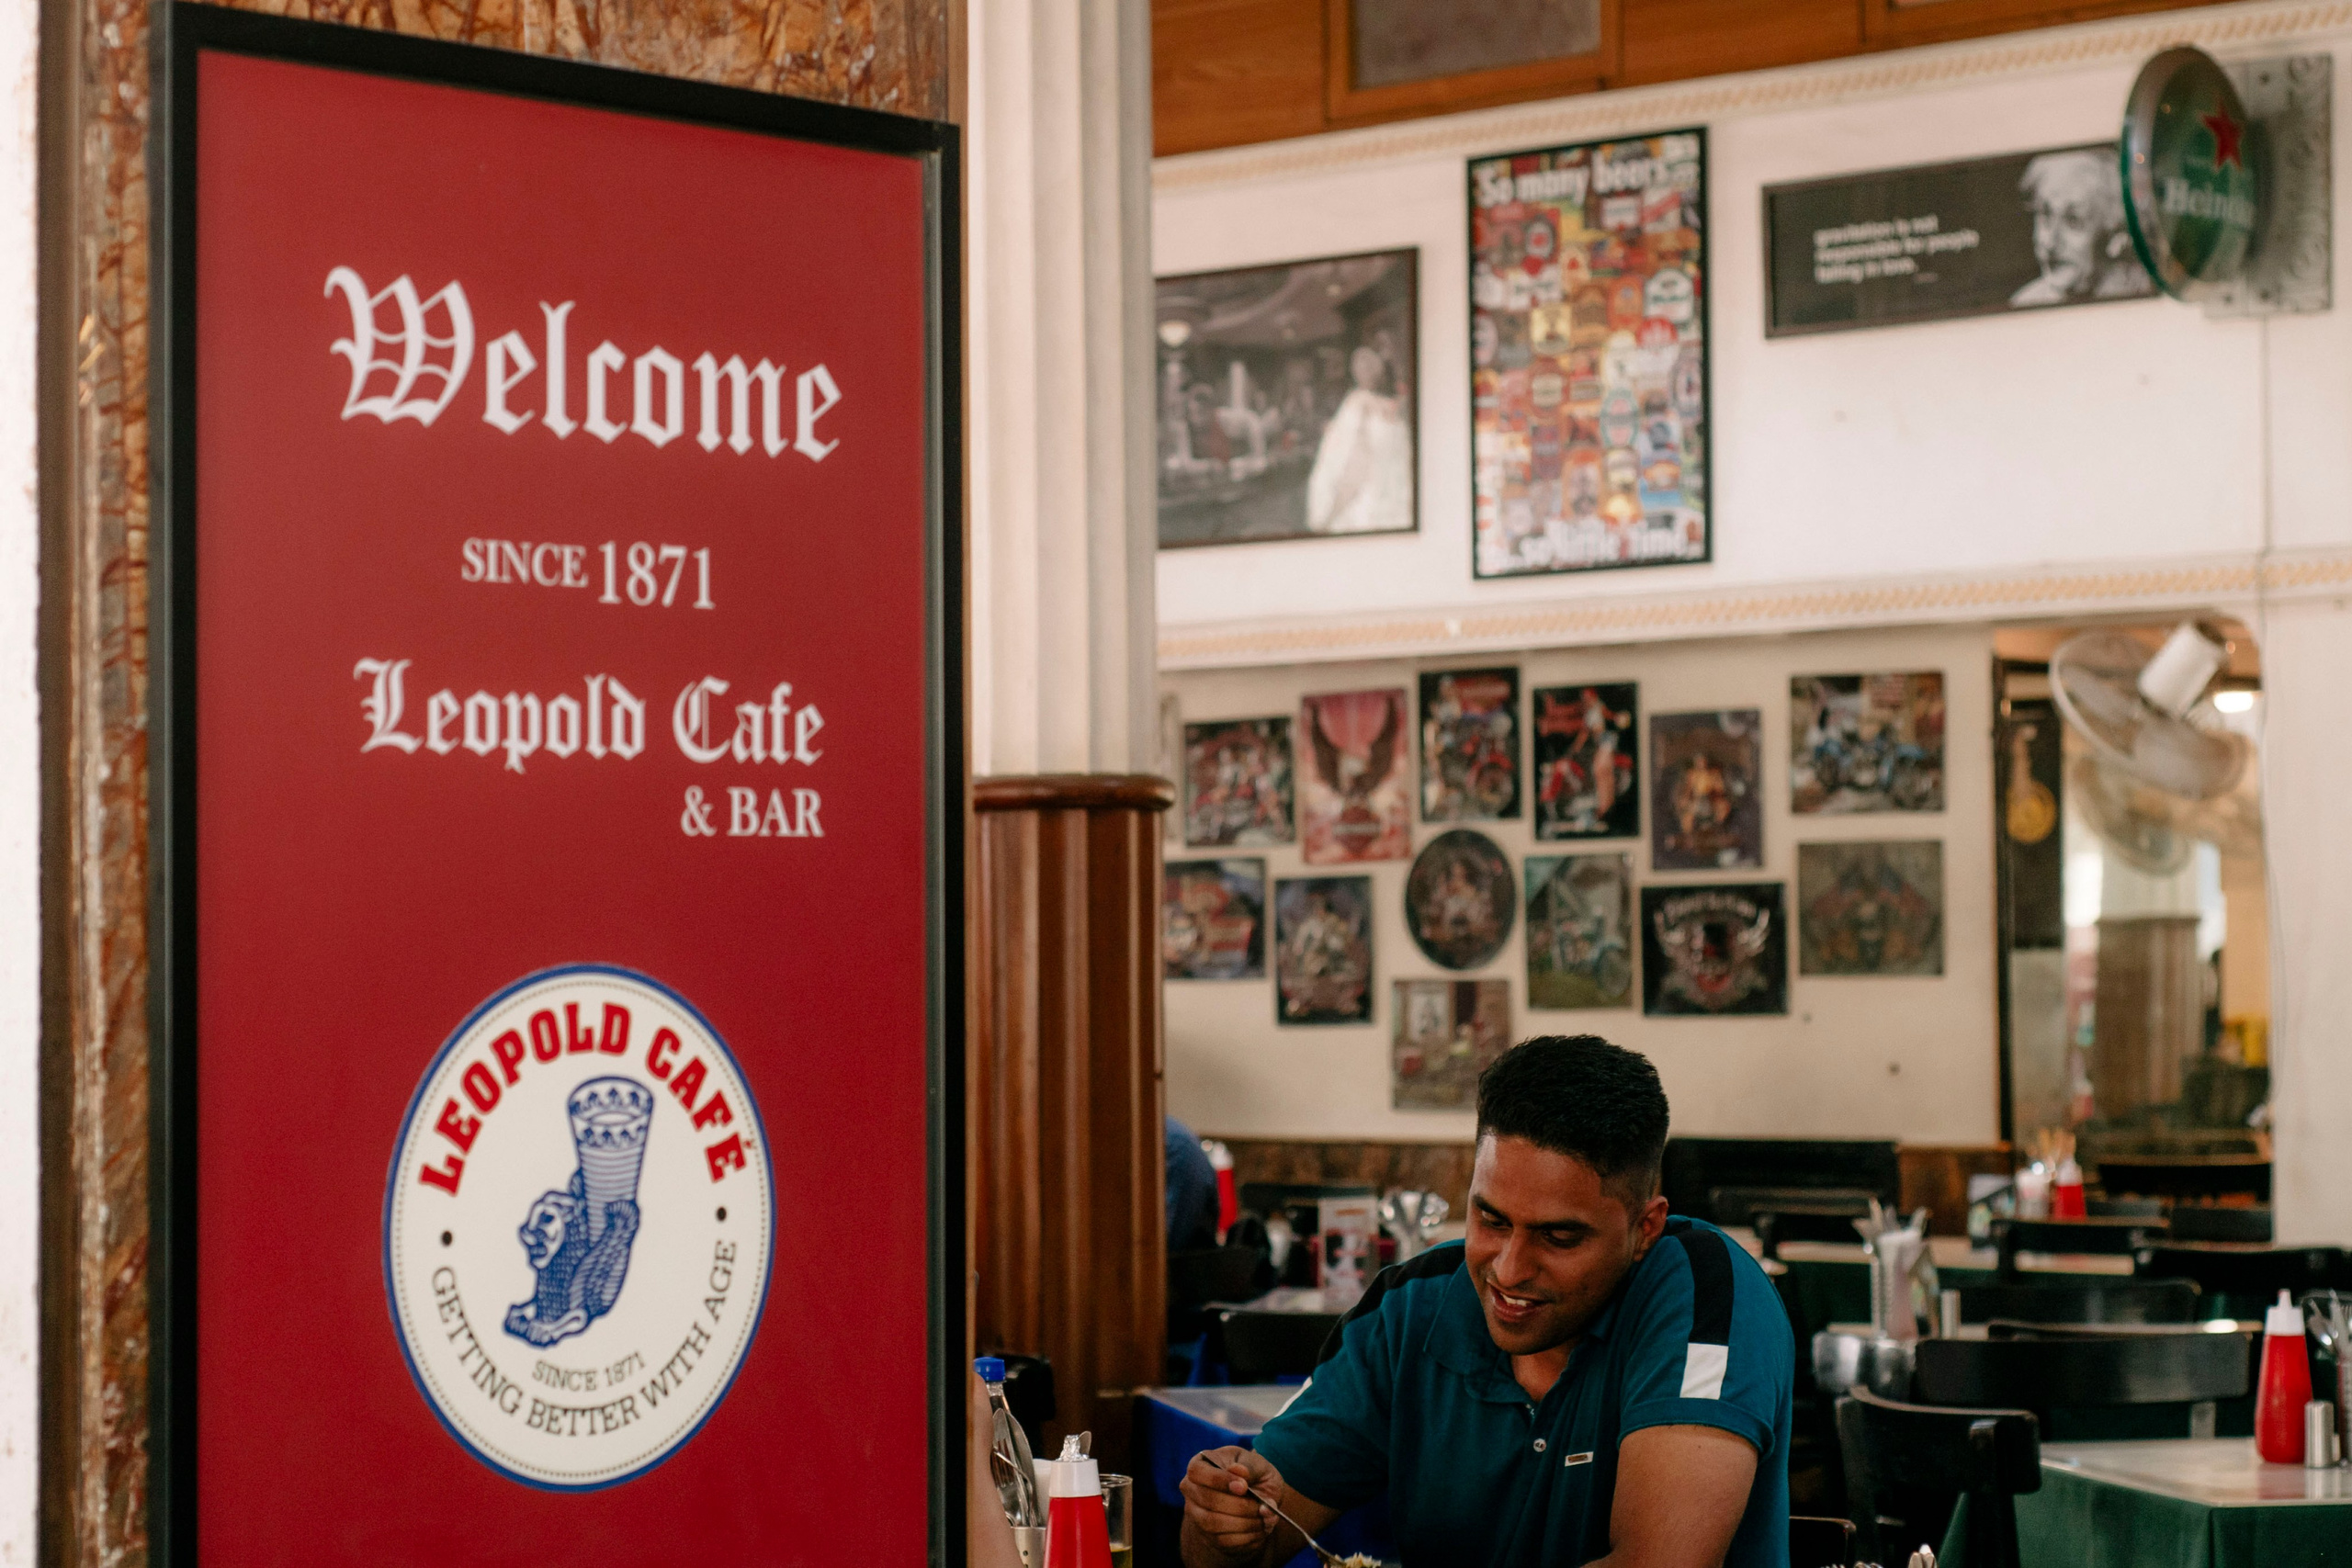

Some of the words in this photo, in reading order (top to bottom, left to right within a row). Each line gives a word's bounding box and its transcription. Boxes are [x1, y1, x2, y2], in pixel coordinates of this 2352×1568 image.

[323, 265, 842, 462] Welcome
[461, 537, 588, 588] SINCE
[599, 541, 714, 609] 1871
[354, 657, 645, 773] Leopold
[673, 676, 824, 765] Cafe
[681, 785, 716, 837] &
[727, 787, 824, 837] BAR
[418, 1002, 631, 1197] LEOPOLD
[646, 1025, 752, 1183] CAFÉ
[431, 1267, 524, 1416] GETTING
[526, 1395, 641, 1437] BETTER
[639, 1321, 711, 1408] WITH
[704, 1239, 737, 1324] AGE
[532, 1359, 597, 1392] SINCE
[605, 1351, 646, 1387] 1871
